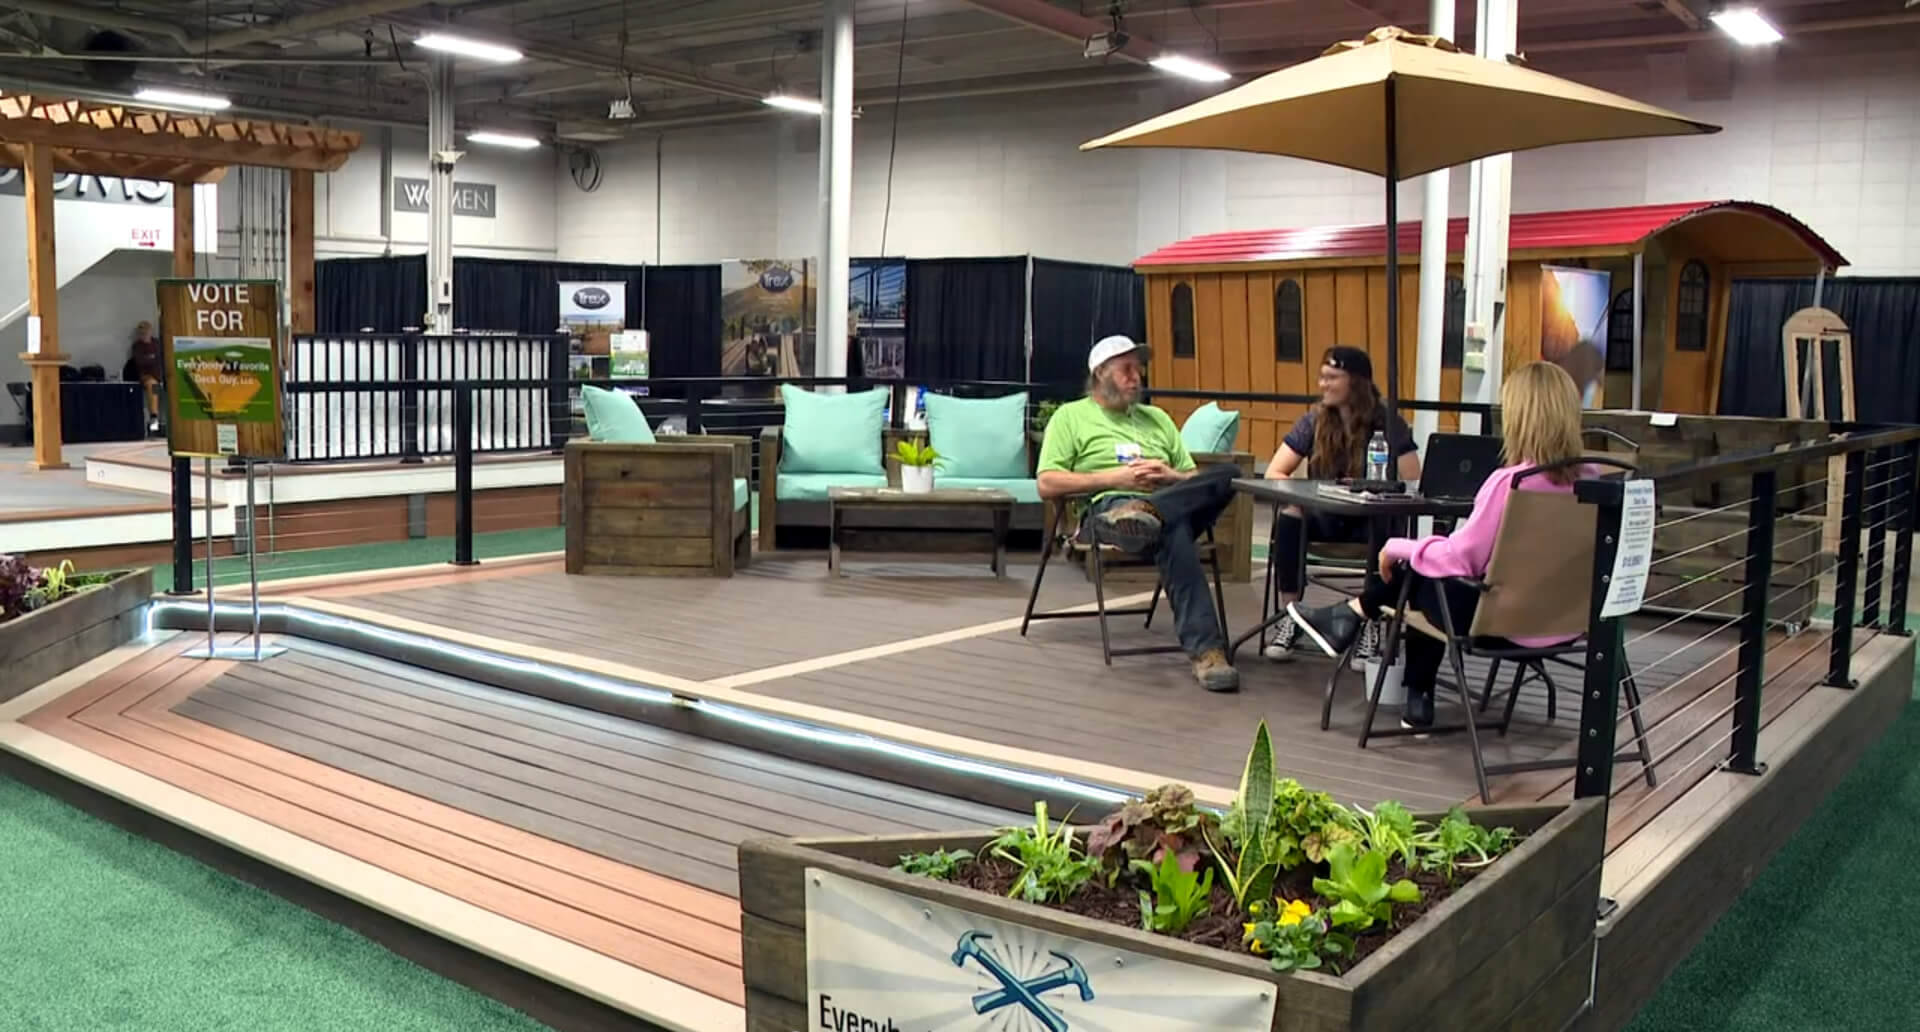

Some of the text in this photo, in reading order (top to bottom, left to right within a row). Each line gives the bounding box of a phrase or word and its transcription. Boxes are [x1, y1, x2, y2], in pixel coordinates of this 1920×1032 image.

[404, 183, 489, 210] WEN
[131, 228, 161, 240] EXIT
[187, 283, 250, 304] VOTE
[577, 291, 607, 305] Trex
[196, 309, 244, 331] FOR
[233, 361, 270, 373] Favorite
